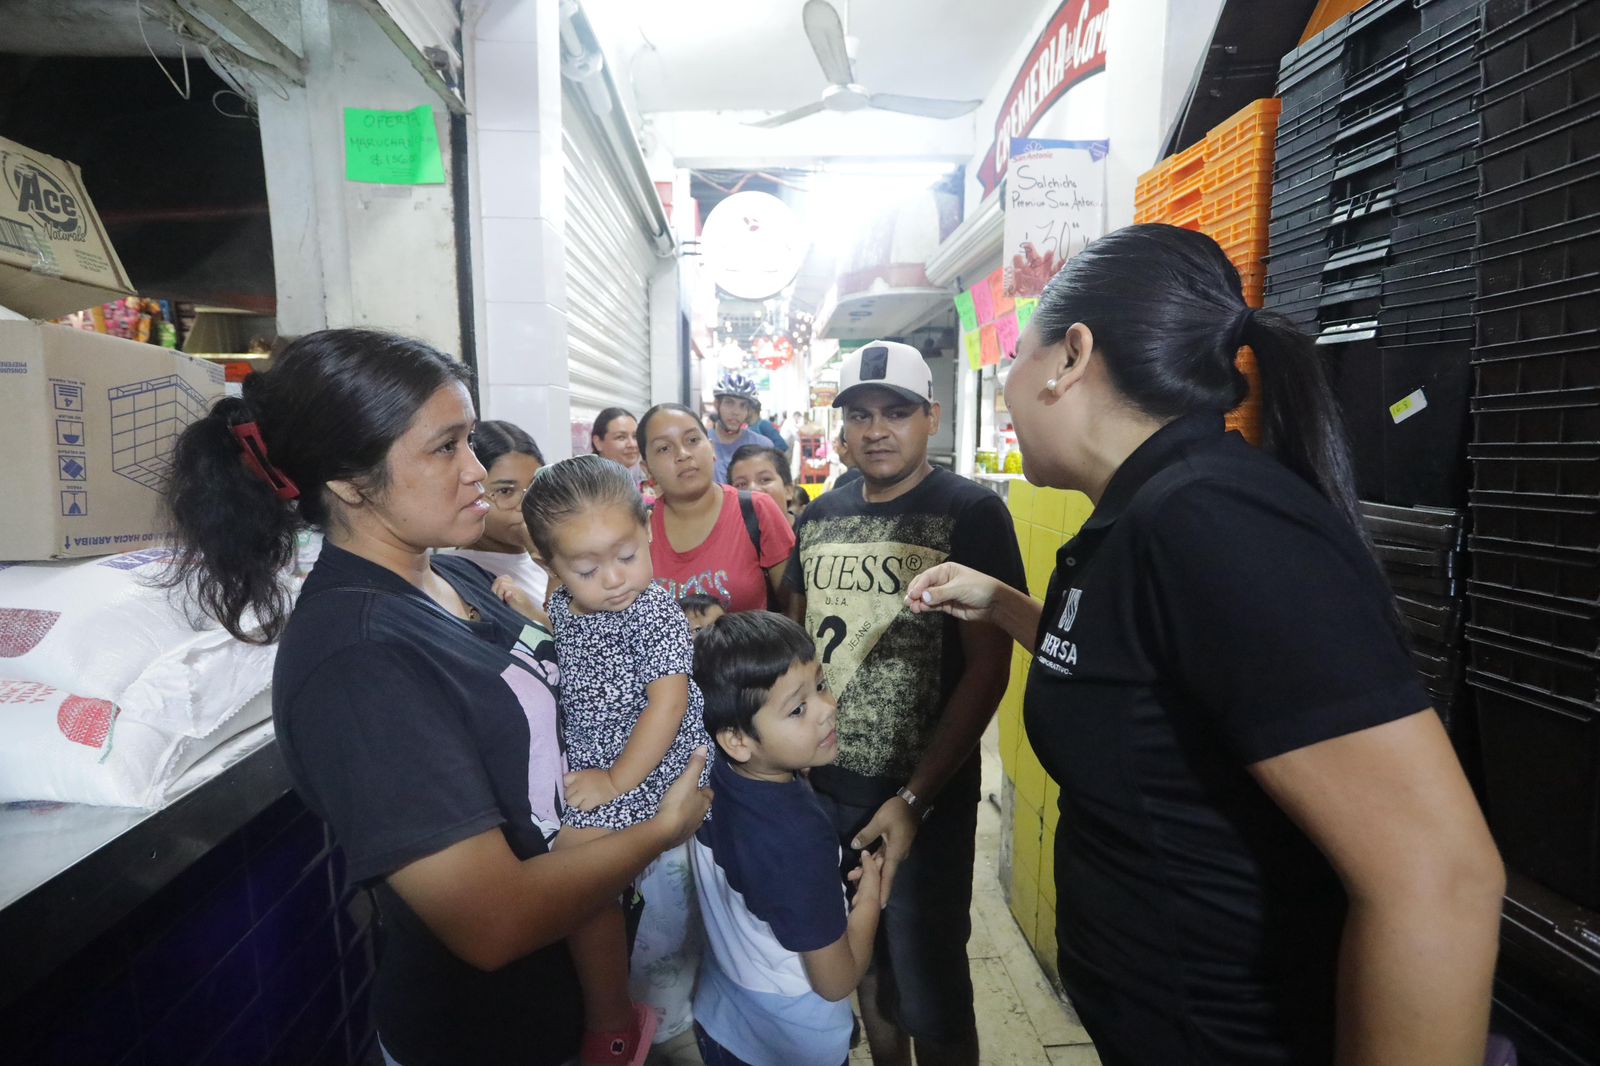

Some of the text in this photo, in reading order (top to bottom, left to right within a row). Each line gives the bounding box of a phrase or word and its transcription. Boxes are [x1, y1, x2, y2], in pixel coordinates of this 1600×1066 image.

[17, 171, 77, 217] Ace
[64, 398, 73, 408] 4
[74, 536, 112, 546] ARRIBA
[847, 620, 872, 651] JEANS
